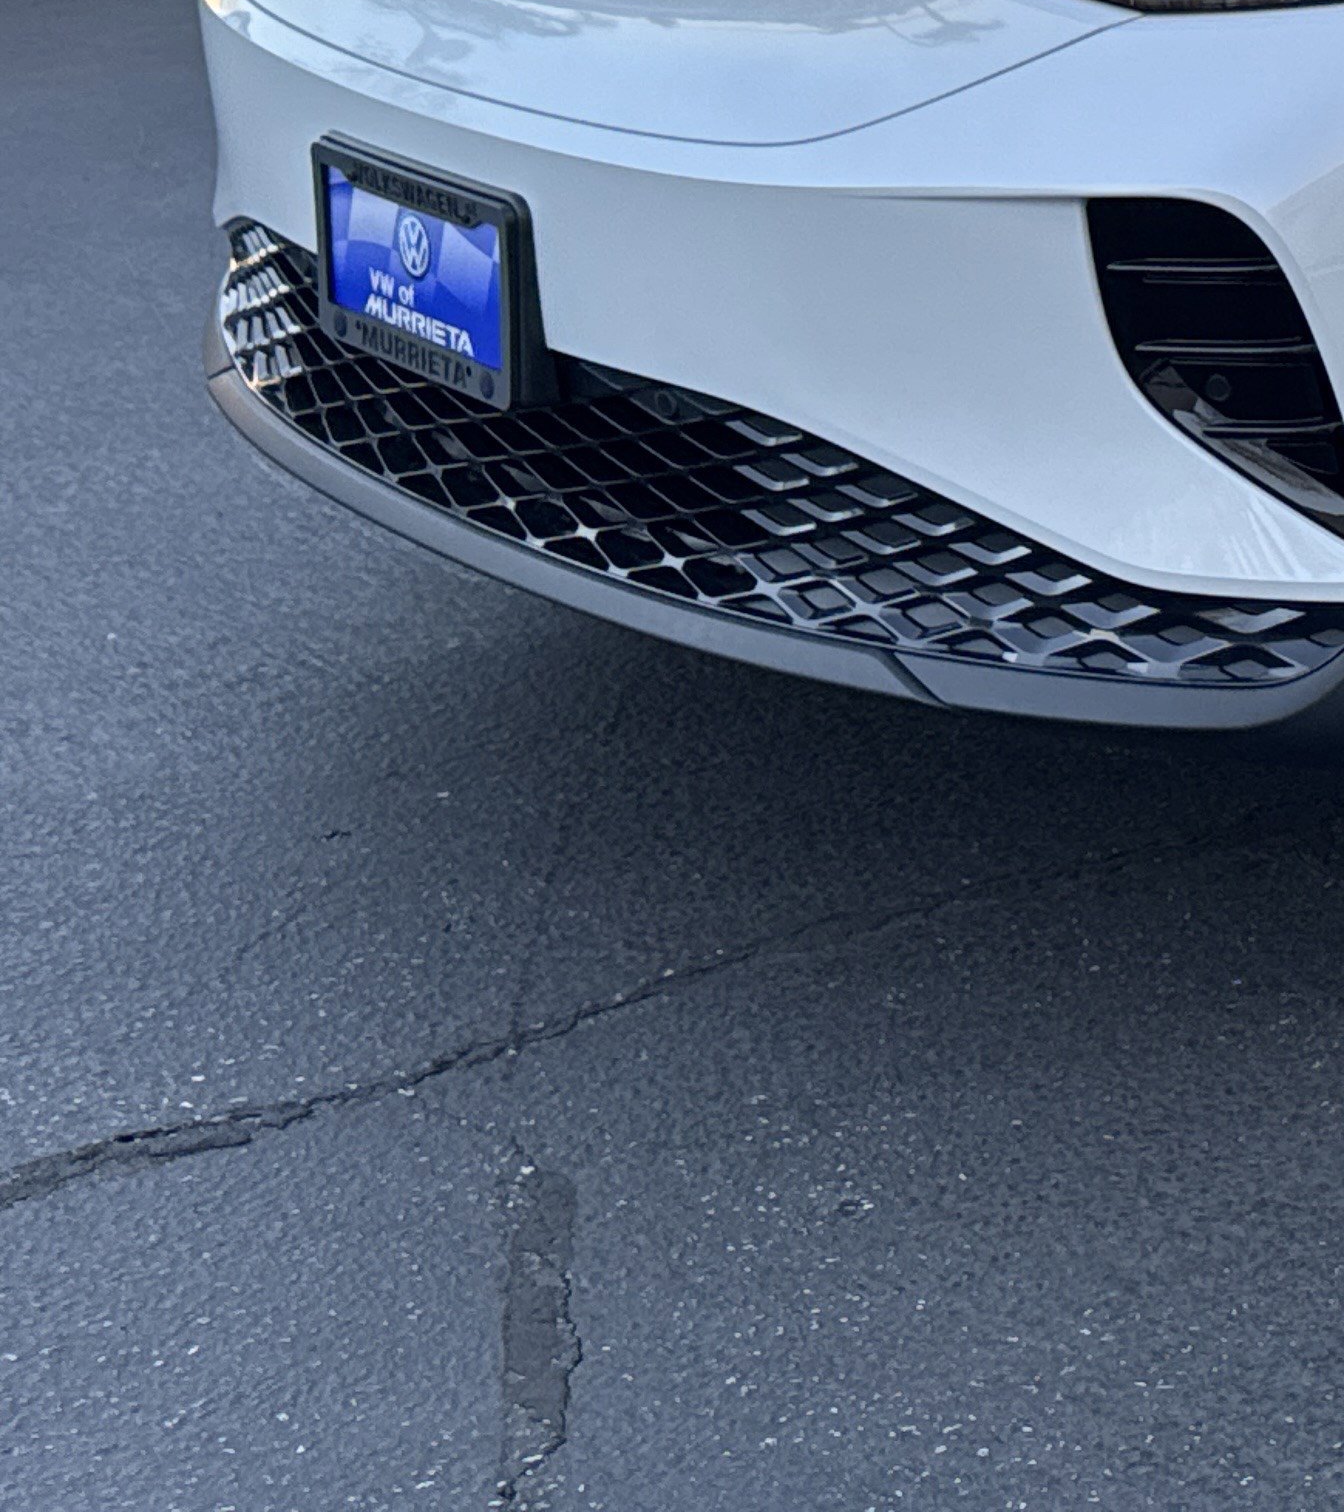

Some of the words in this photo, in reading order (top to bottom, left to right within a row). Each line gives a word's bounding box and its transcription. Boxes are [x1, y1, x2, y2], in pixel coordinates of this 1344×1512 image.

[369, 267, 394, 299] VW
[398, 284, 415, 308] of
[363, 323, 467, 388] MURRIETA
[364, 293, 475, 358] MURRIETA
